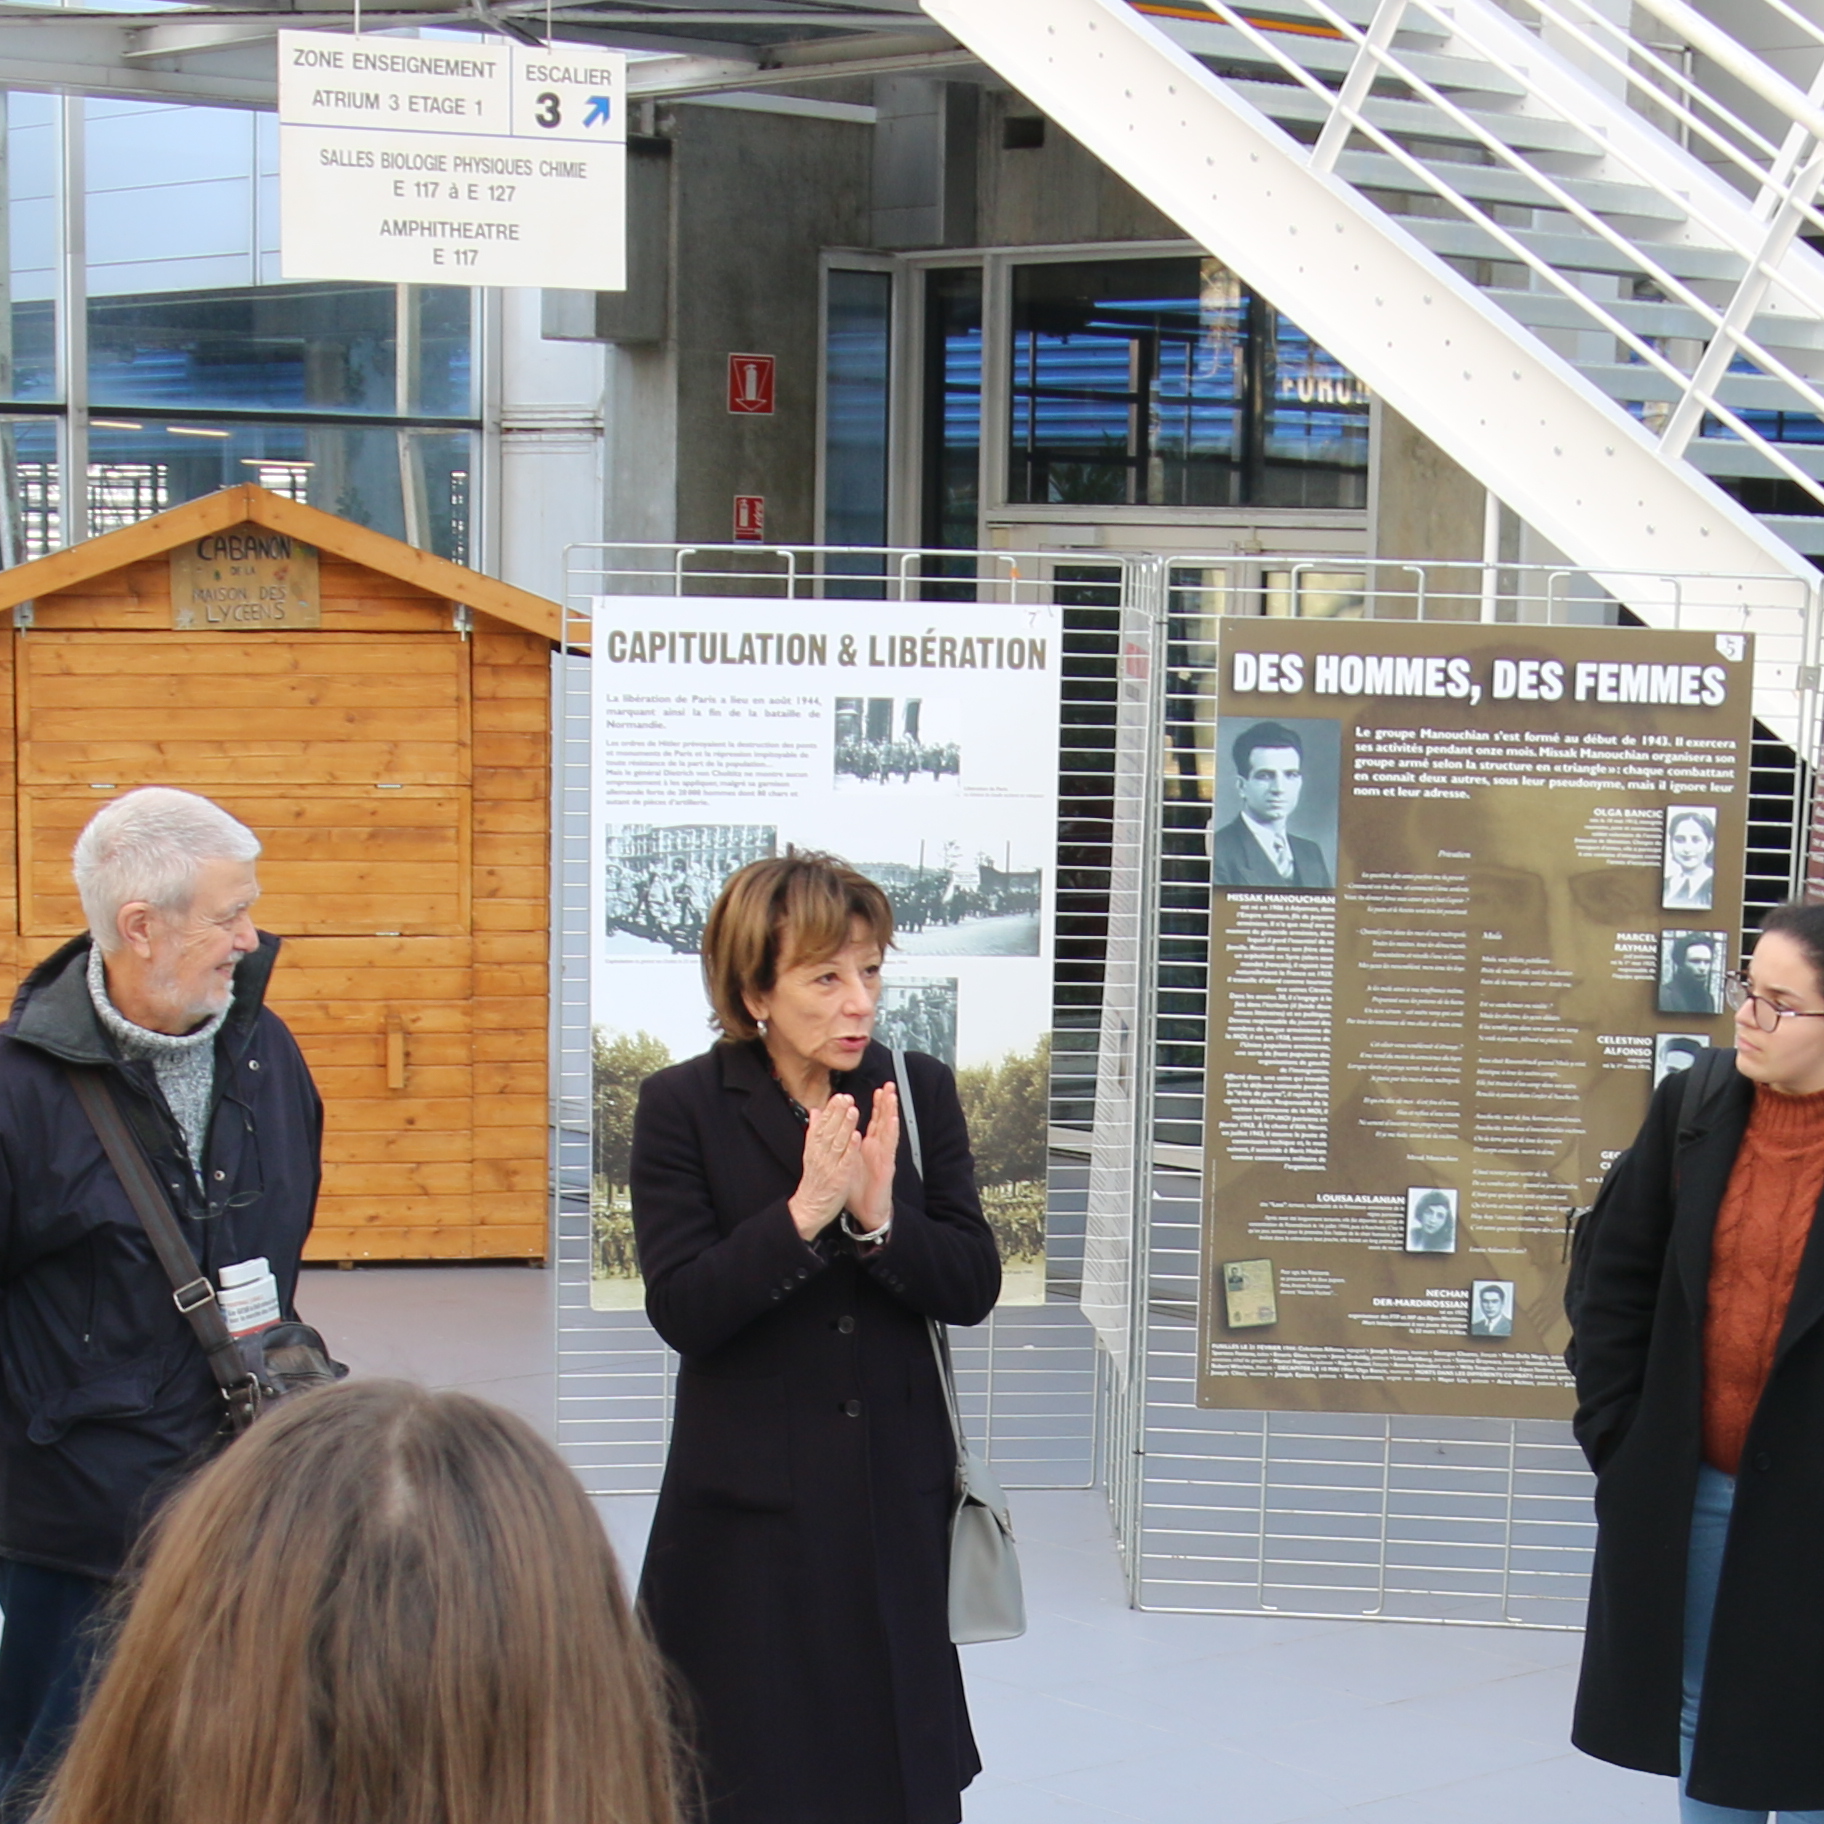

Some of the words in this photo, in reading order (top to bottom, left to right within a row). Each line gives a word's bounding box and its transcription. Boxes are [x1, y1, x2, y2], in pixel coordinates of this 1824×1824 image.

[293, 49, 344, 70] ZONE
[353, 53, 496, 79] ENSEIGNEMENT
[526, 65, 612, 86] ESCALIER
[312, 90, 379, 110] ATRIUM
[388, 94, 400, 111] 3
[409, 95, 466, 115] ETAGE
[475, 99, 483, 116] 1
[534, 92, 561, 128] 3
[320, 149, 374, 169] SALLES
[381, 152, 447, 173] BIOLOGIE
[453, 155, 532, 176] PHYSIQUES
[539, 158, 587, 179] CHIMIE
[393, 180, 405, 197] E
[414, 181, 439, 199] 117
[448, 181, 459, 199] à
[467, 183, 478, 201] E
[488, 184, 516, 202] 127
[379, 219, 520, 241] AMPHITHEATRE
[433, 249, 444, 265] E
[453, 249, 479, 267] 117
[197, 535, 292, 561] CABANON
[231, 566, 242, 576] DE
[245, 566, 256, 576] LA
[193, 586, 247, 603] MAISON
[259, 585, 287, 600] DES
[1027, 611, 1039, 627] 7
[607, 629, 827, 667] CAPITULATION
[837, 635, 858, 667] &
[868, 627, 1047, 671] LIBÉRATION
[1234, 652, 1304, 693] DES
[1315, 654, 1481, 705] HOMMES,
[1493, 660, 1565, 700] DES
[1575, 661, 1726, 707] FEMMES
[606, 694, 619, 702] La
[622, 694, 671, 703] libération
[675, 695, 687, 703] de
[692, 695, 716, 704] Paris
[730, 695, 748, 704] lieu
[769, 696, 791, 705] août
[797, 696, 822, 708] 1944,
[606, 707, 655, 718] marquant
[663, 708, 685, 716] ainsi
[692, 708, 701, 716] la
[709, 708, 721, 716] fin
[729, 708, 741, 717] de
[748, 708, 757, 717] la
[764, 709, 800, 717] bataille
[808, 709, 820, 718] de
[606, 720, 666, 729] Normandie.
[1356, 727, 1371, 738] Le
[1375, 731, 1416, 742] groupe
[1420, 729, 1490, 741] Manouchian
[1494, 732, 1520, 742] s'est
[1525, 732, 1560, 743] formé
[1583, 734, 1617, 745] début
[1622, 735, 1636, 746] de
[1642, 736, 1672, 747] 1943.
[1676, 737, 1684, 747] Il
[1686, 740, 1736, 749] exercera
[1376, 743, 1423, 754] activités
[1426, 744, 1473, 757] pendant
[1476, 748, 1503, 756] onze
[1506, 747, 1538, 757] mois.
[1539, 747, 1577, 758] Missak
[1580, 748, 1649, 760] Manouchian
[1652, 751, 1712, 764] organisera
[1593, 808, 1622, 817] OLGA
[1624, 809, 1664, 819] BANCIC
[1227, 893, 1264, 903] MISSAK
[1265, 894, 1336, 905] MANOUCHIAN
[1617, 933, 1657, 943] MARCEL
[1615, 943, 1657, 953] RAYMAN
[1597, 1035, 1652, 1046] CELESTINO
[1604, 1046, 1652, 1057] ALFONSO
[1317, 1194, 1355, 1204] LOUISA
[1355, 1195, 1405, 1205] ASLANIAN
[1426, 1289, 1469, 1299] NECHAN
